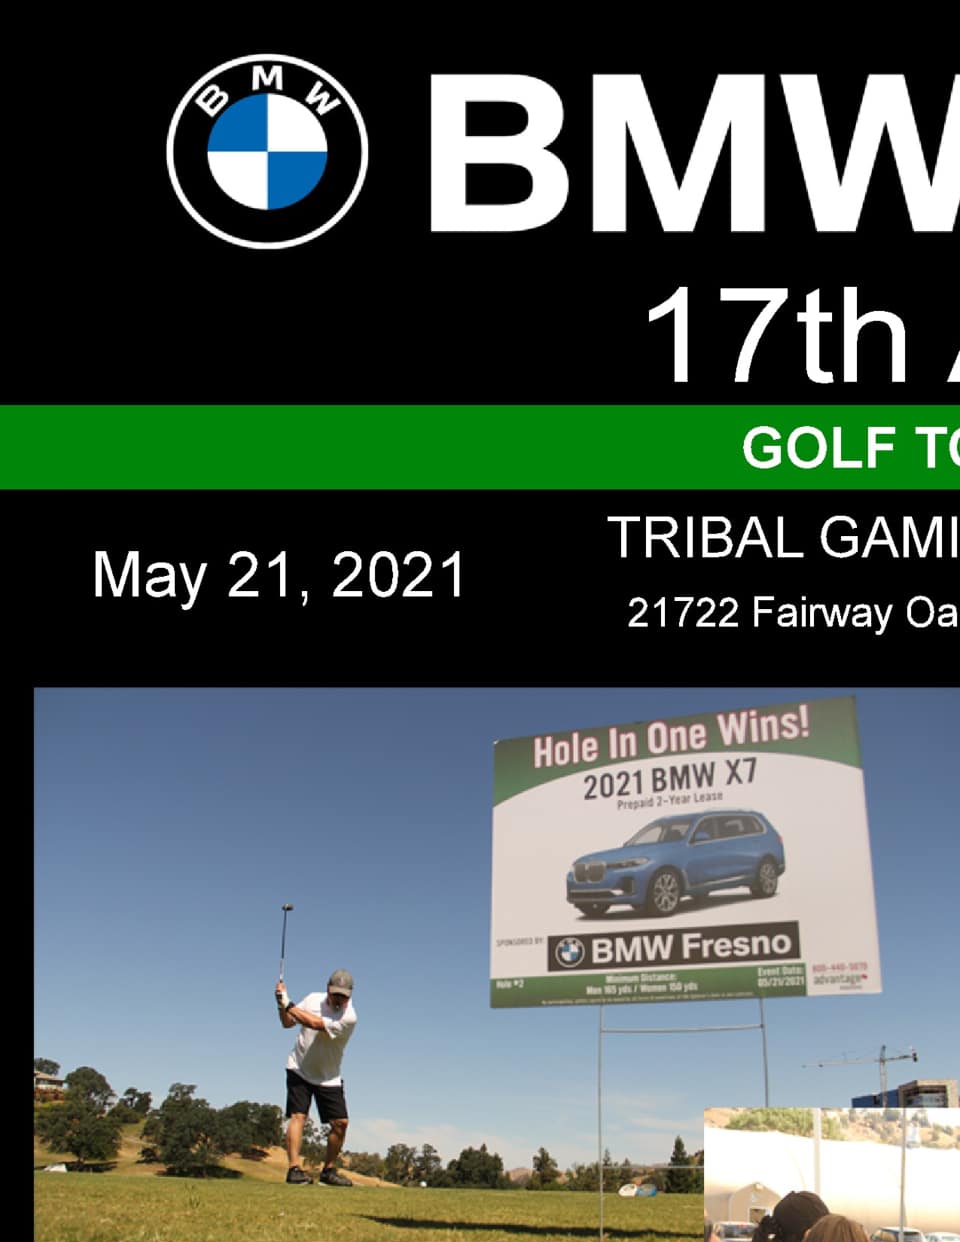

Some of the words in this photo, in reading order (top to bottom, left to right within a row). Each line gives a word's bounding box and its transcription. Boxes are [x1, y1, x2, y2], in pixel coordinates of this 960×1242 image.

[533, 732, 599, 769] Hole
[608, 727, 637, 759] In
[647, 721, 707, 755] One
[717, 704, 810, 746] Wins!
[584, 769, 643, 800] 2021
[652, 761, 715, 793] BMW
[726, 757, 757, 785] X7
[617, 797, 654, 810] Prepaid
[656, 794, 691, 808] 2-Year
[694, 791, 723, 804] Lease
[591, 934, 674, 964] BMW
[682, 933, 792, 959] Fresno
